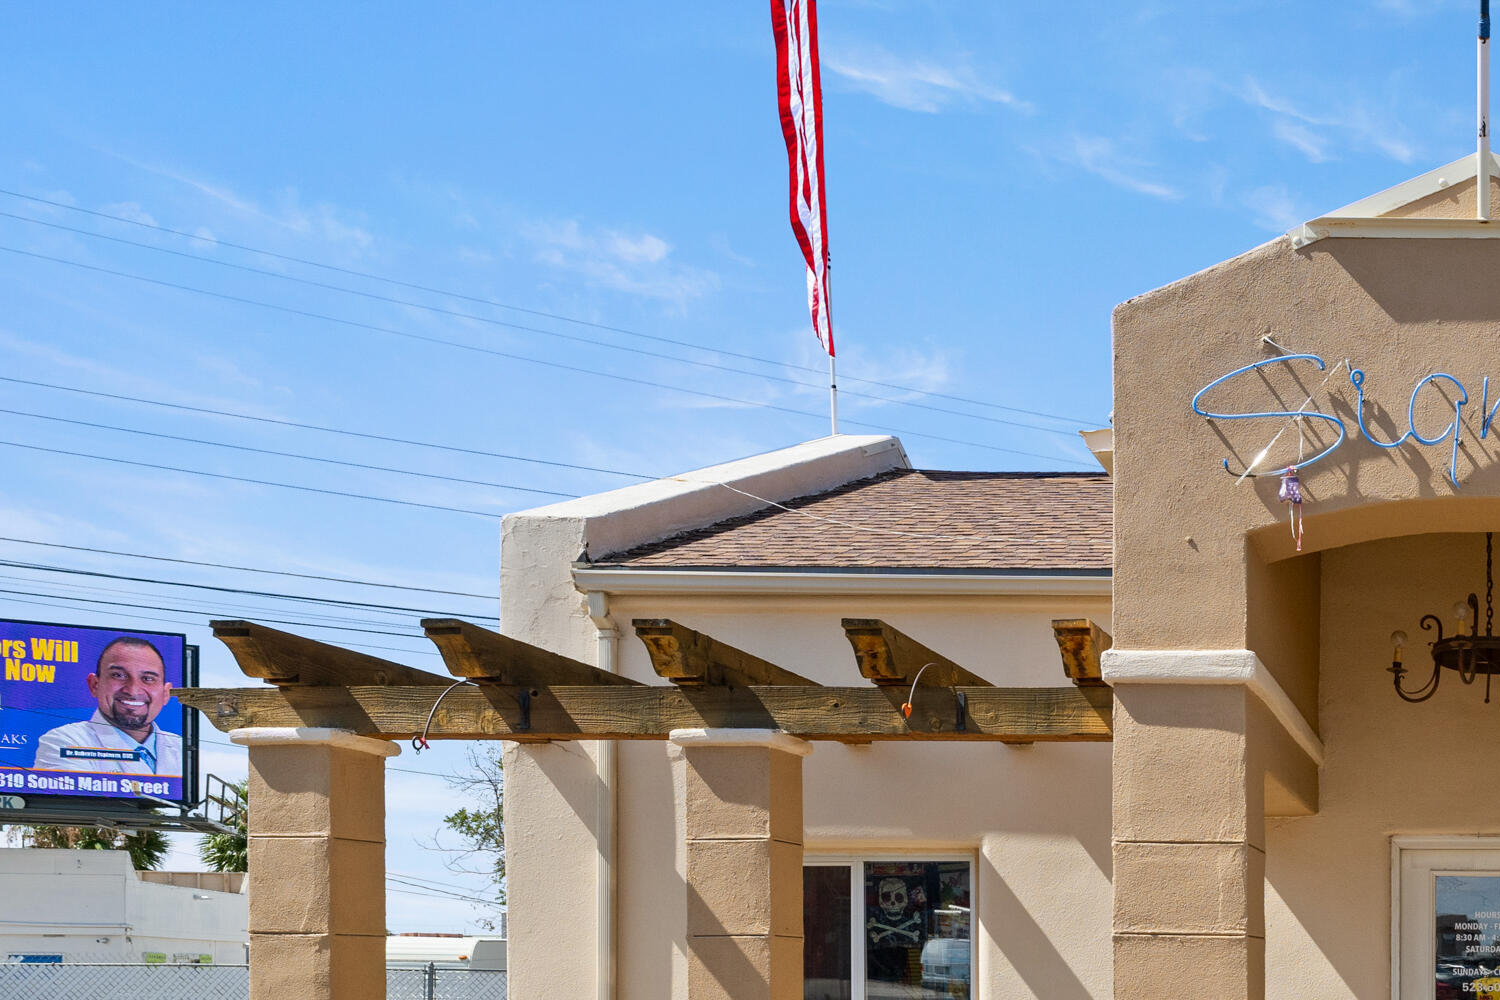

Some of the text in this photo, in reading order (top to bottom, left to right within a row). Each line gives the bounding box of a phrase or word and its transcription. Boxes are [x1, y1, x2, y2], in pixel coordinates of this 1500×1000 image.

[0, 637, 78, 663] rs Will
[5, 658, 56, 684] Now
[1, 734, 28, 745] AKS
[27, 774, 75, 790] South
[78, 776, 118, 793] Main
[121, 778, 170, 795] Sreet
[0, 796, 15, 808] K
[1474, 911, 1500, 919] HOURS
[1454, 922, 1488, 931] MONDAY
[1455, 934, 1472, 942] 8:30
[1473, 934, 1486, 942] AM
